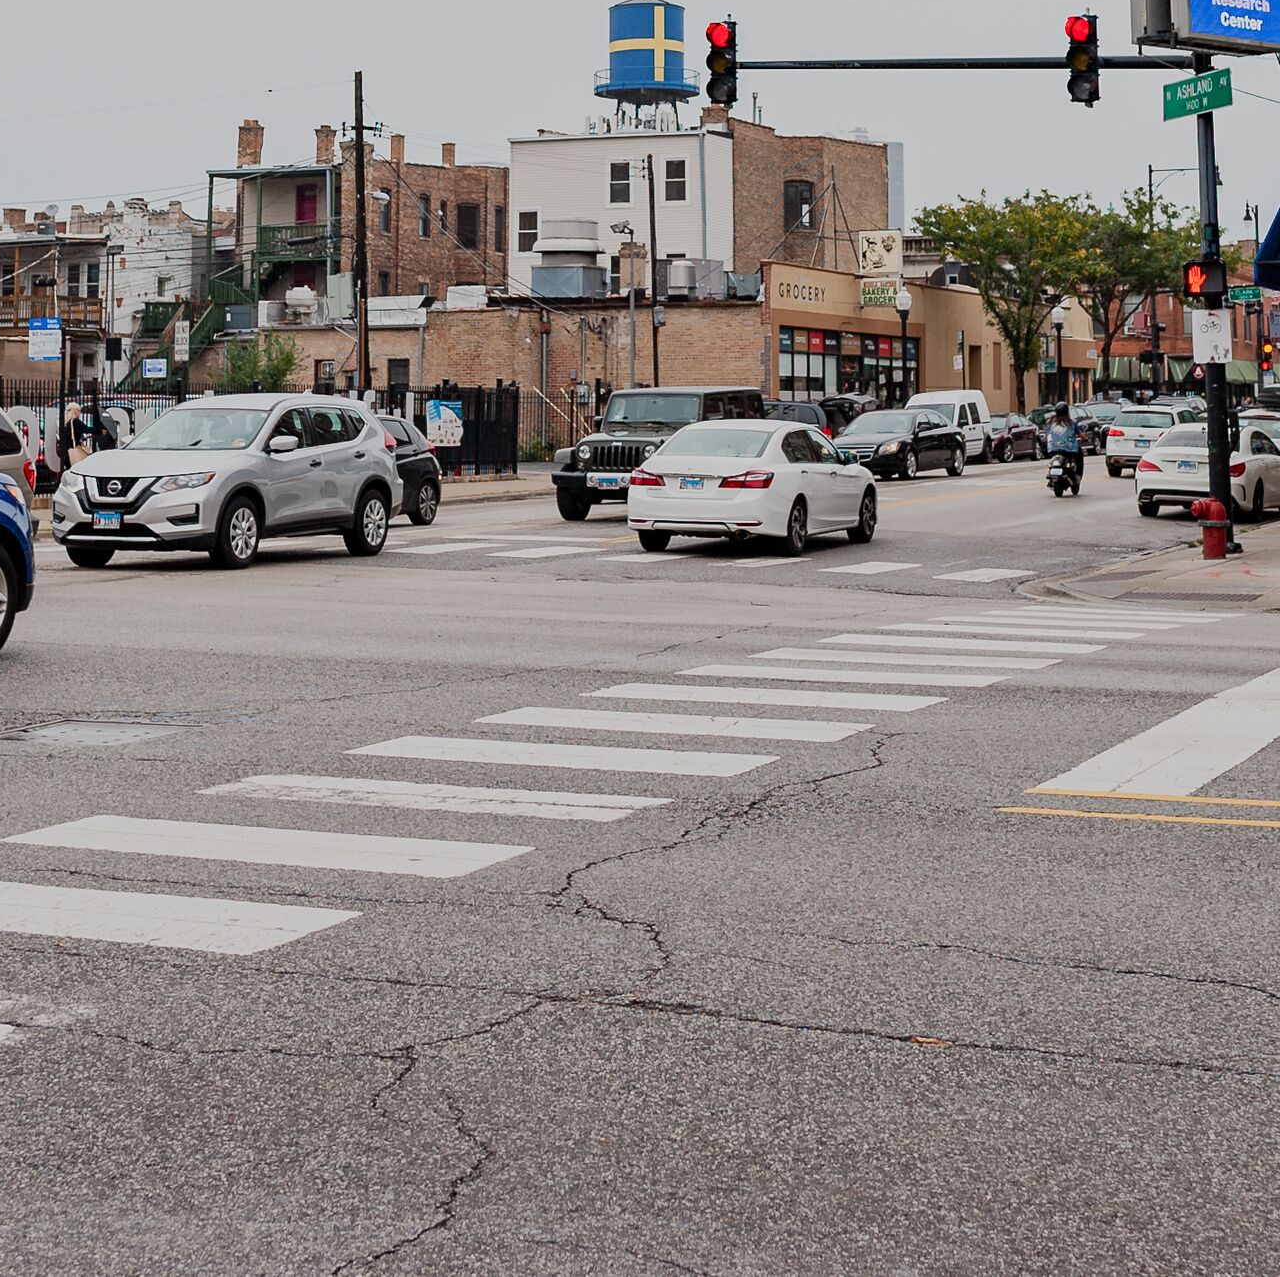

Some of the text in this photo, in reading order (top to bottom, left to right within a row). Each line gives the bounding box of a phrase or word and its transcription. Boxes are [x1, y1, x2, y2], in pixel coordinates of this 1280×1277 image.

[1221, 12, 1263, 31] Center
[1177, 78, 1213, 100] ASHLAND
[779, 283, 826, 302] GROCERY
[862, 288, 890, 296] BAKERY
[863, 295, 897, 305] GROCERY
